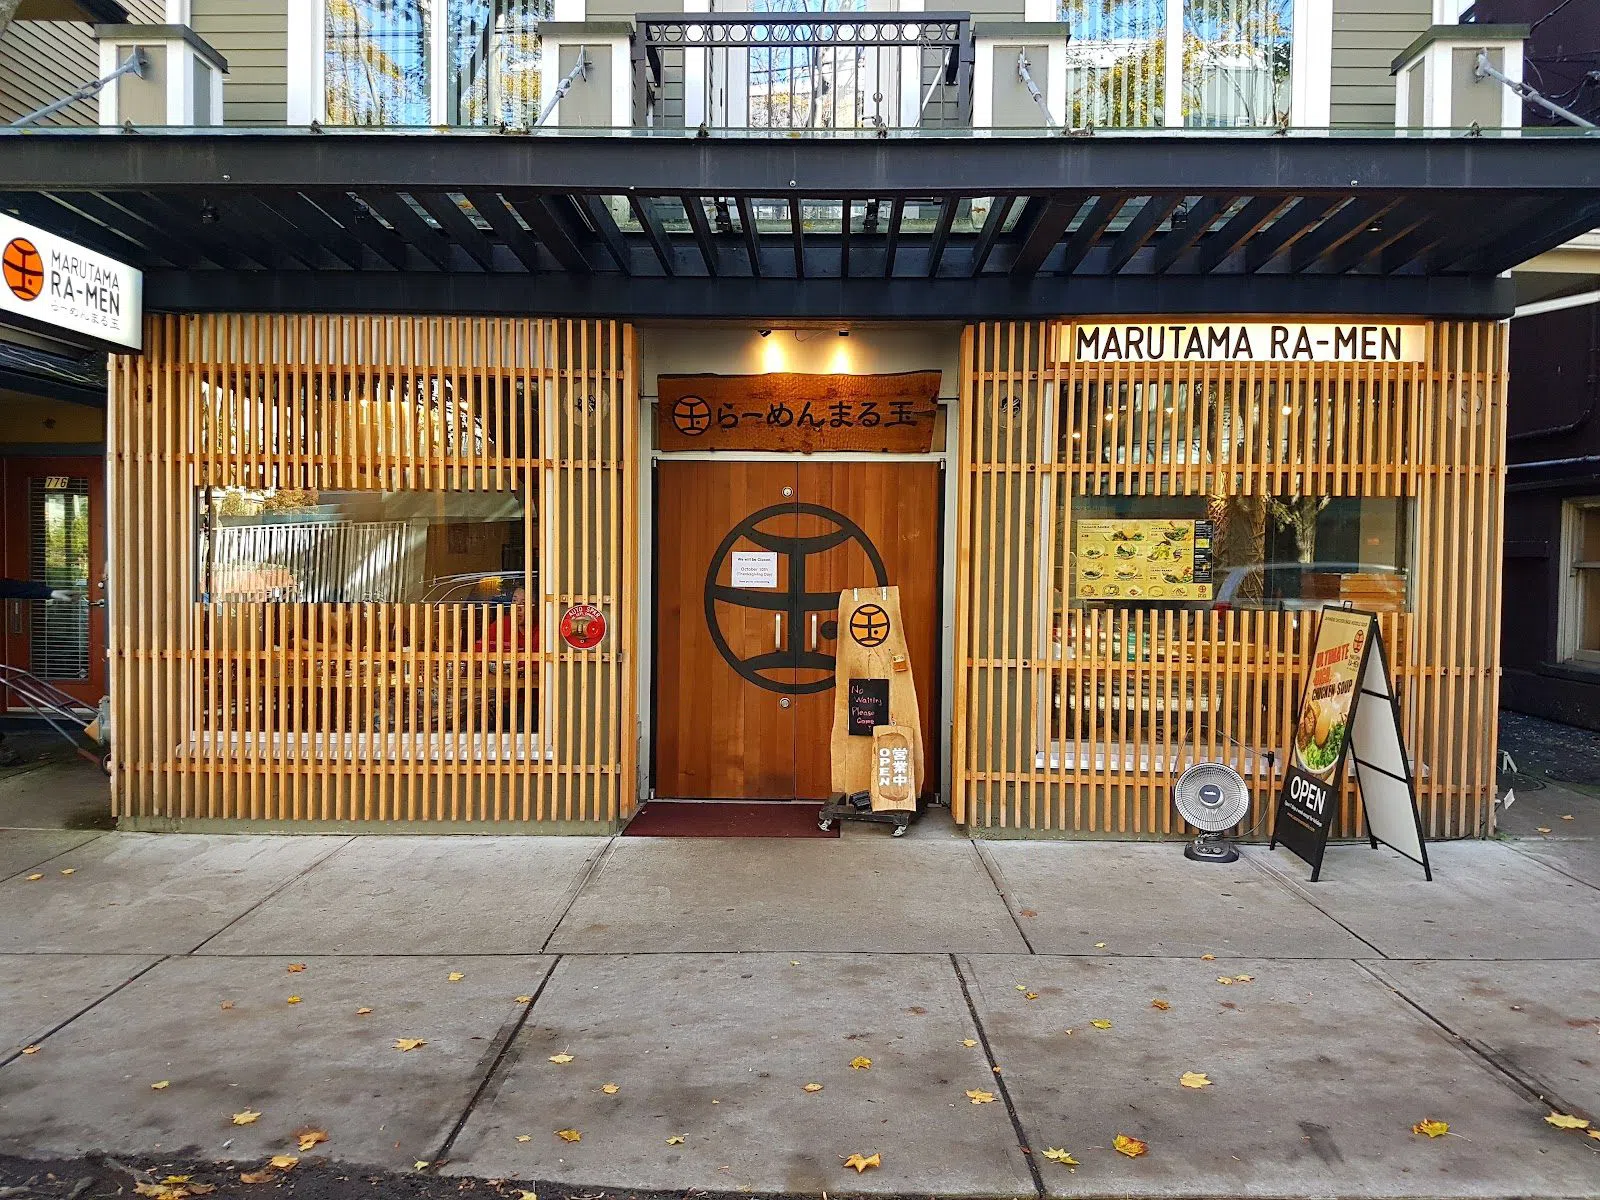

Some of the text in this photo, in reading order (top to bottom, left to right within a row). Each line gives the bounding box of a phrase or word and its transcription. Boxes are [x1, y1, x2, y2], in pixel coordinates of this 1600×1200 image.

[51, 248, 119, 291] MARUTAMA
[51, 270, 120, 317] RA-MEN
[1076, 326, 1401, 361] MARUTAMA RA-MEN
[717, 401, 918, 430] らーめんまる玉
[47, 477, 68, 488] 776
[568, 606, 583, 617] AUTO
[851, 685, 864, 695] No
[1311, 679, 1353, 701] CHICKEN SOUP
[851, 705, 875, 716] Please
[879, 748, 890, 787] OPEN
[892, 747, 908, 787] 営業中
[1290, 775, 1326, 815] OPEN
